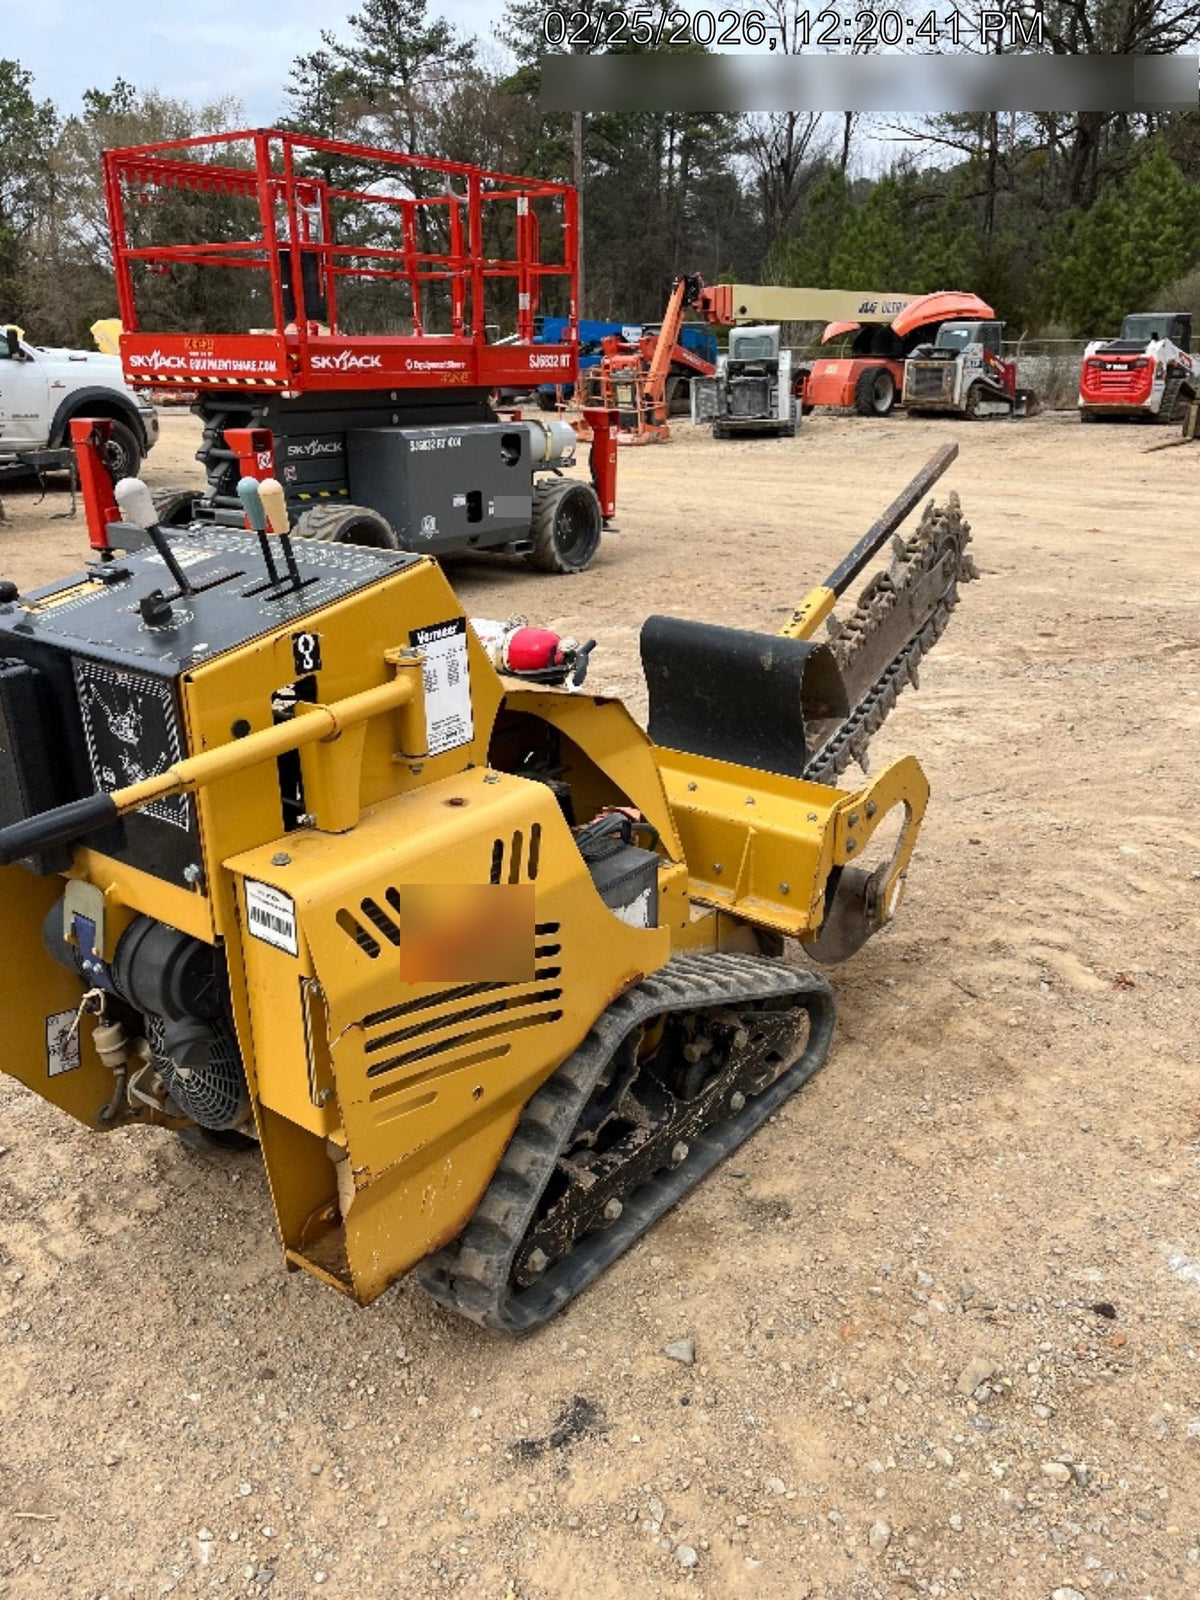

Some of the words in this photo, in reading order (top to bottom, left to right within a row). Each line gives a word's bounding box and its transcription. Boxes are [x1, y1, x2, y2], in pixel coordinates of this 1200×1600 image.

[129, 350, 187, 370] SKYJACK
[189, 358, 277, 372] EQUIPMENTSHARE.COM
[310, 350, 382, 370] SKYJACK
[287, 439, 342, 456] SKYJACK
[416, 625, 458, 645] Vermeer
